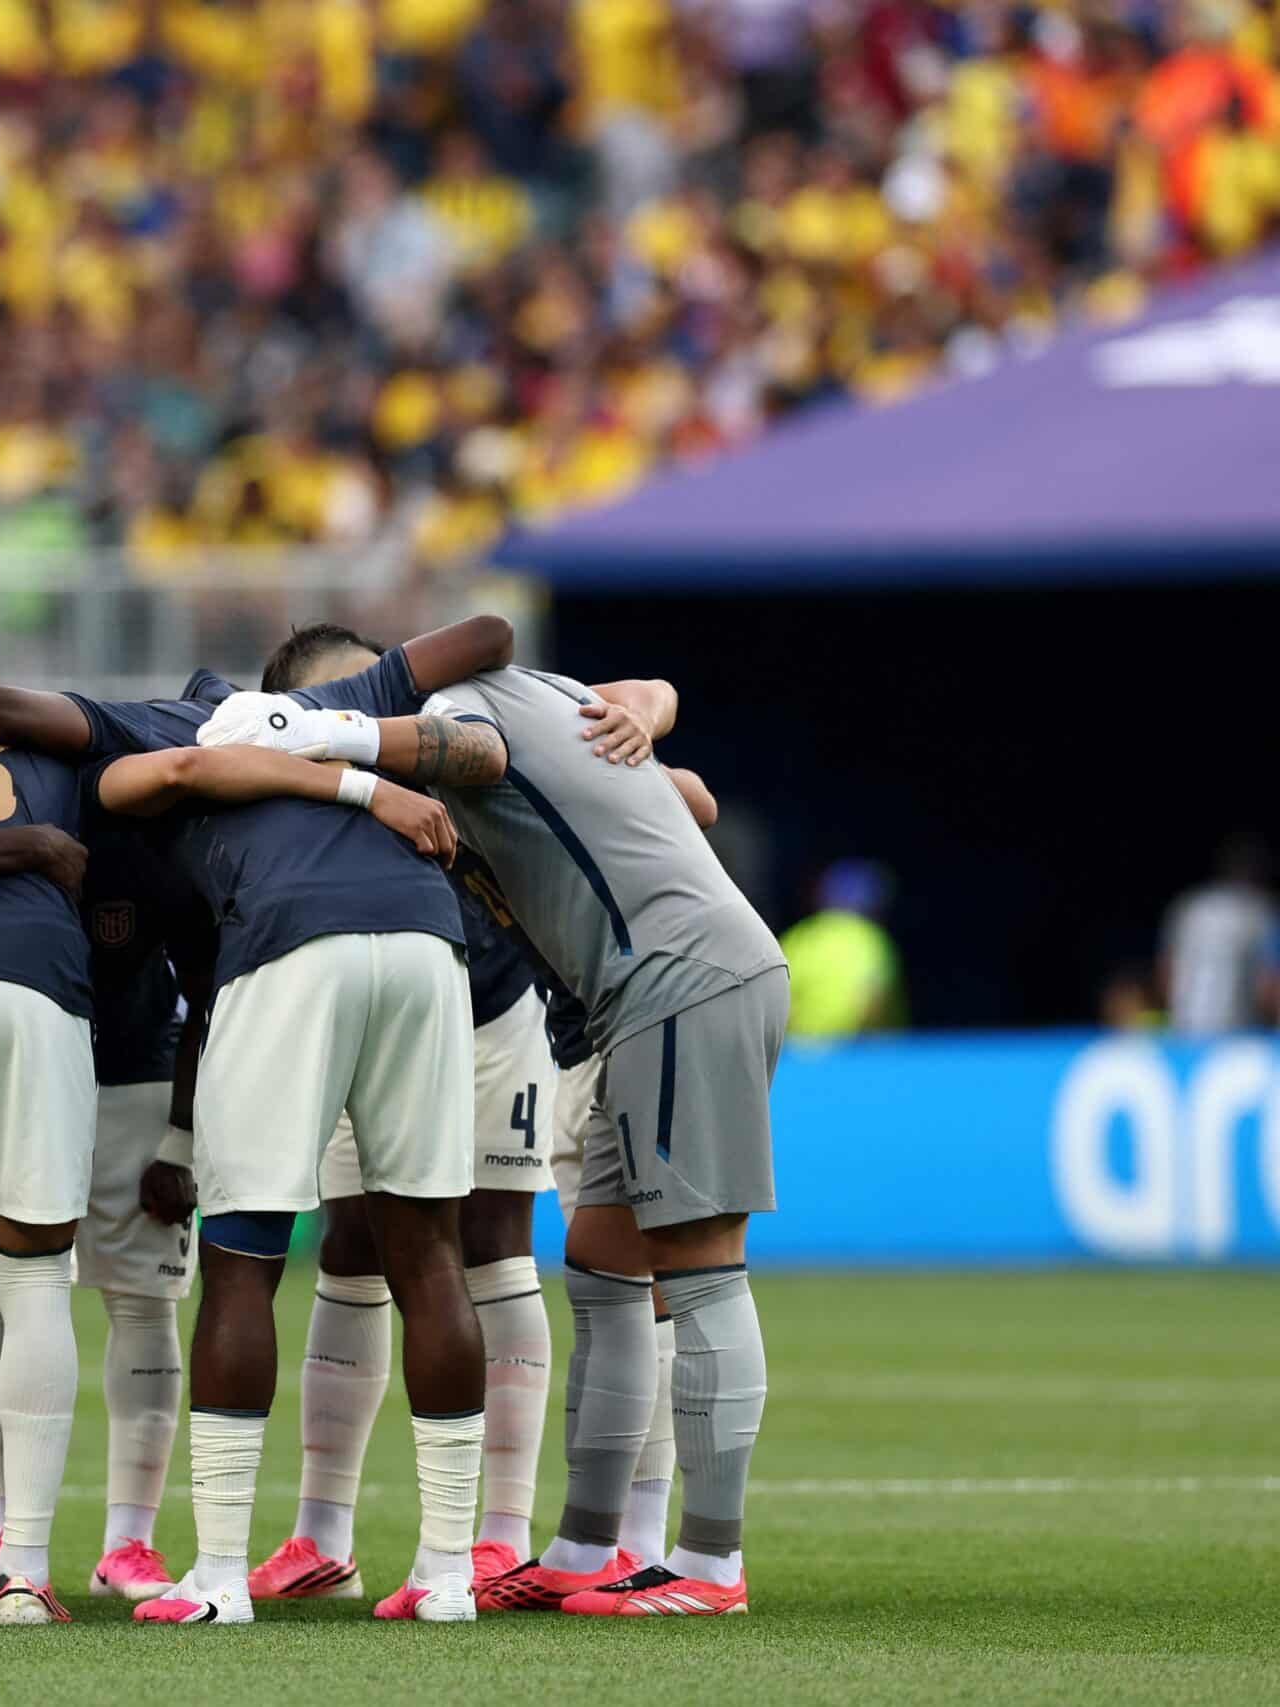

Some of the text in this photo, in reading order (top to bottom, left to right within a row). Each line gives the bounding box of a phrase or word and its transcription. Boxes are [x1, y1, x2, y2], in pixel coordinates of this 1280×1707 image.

[510, 1082, 538, 1150] 4
[617, 1111, 637, 1181] 1
[1048, 1034, 1280, 1262] ar
